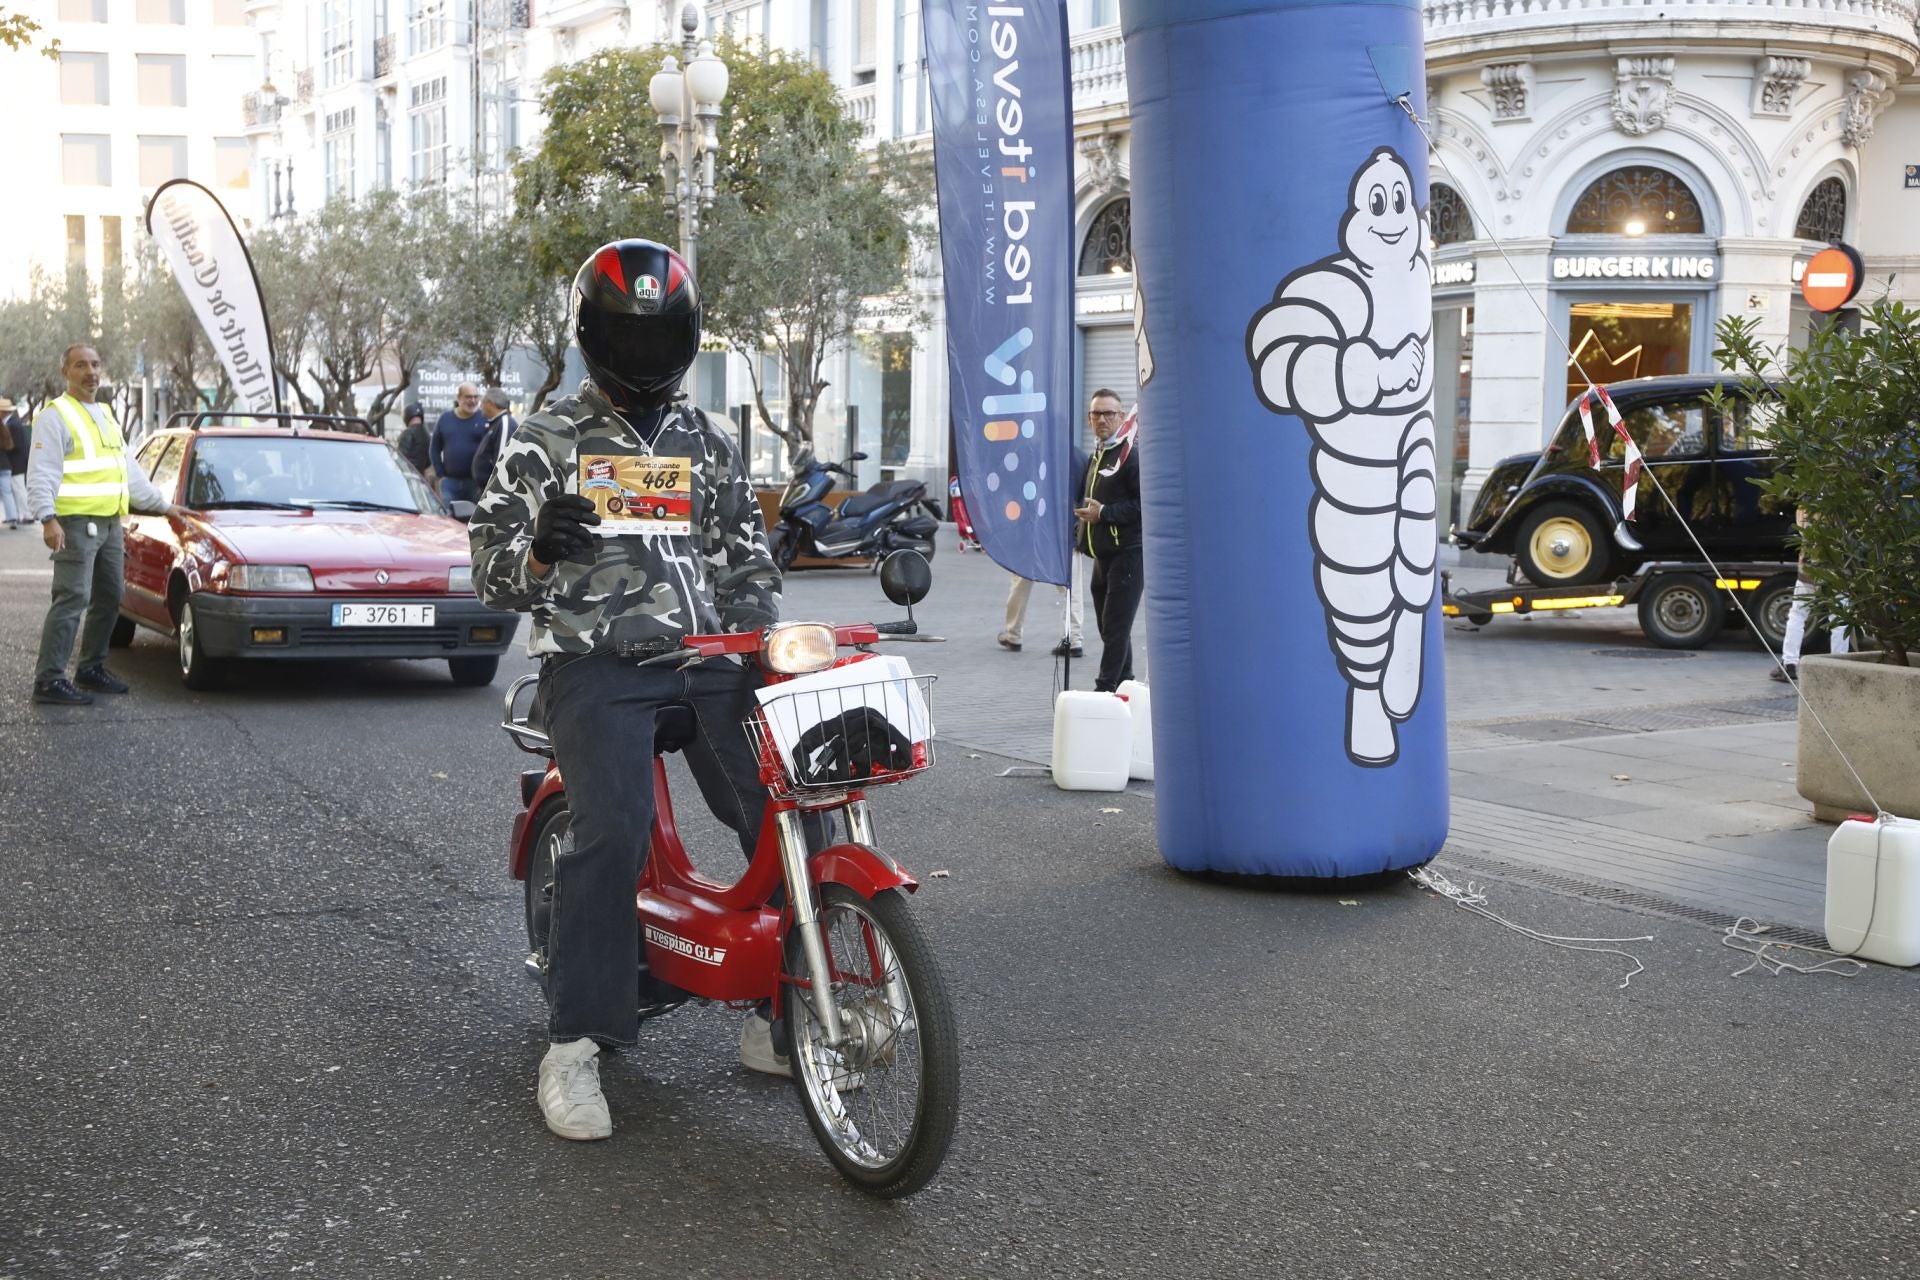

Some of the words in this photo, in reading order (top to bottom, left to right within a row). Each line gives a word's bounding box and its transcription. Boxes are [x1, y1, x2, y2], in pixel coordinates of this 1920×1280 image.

[1553, 257, 1648, 278] BURGER
[418, 369, 448, 382] Todo
[418, 384, 459, 395] cuand
[634, 461, 680, 470] Participante
[642, 471, 680, 489] 468
[343, 607, 352, 623] P
[366, 607, 406, 623] 3761
[422, 607, 433, 623] F
[652, 930, 693, 955] vespino
[694, 945, 714, 961] GL
